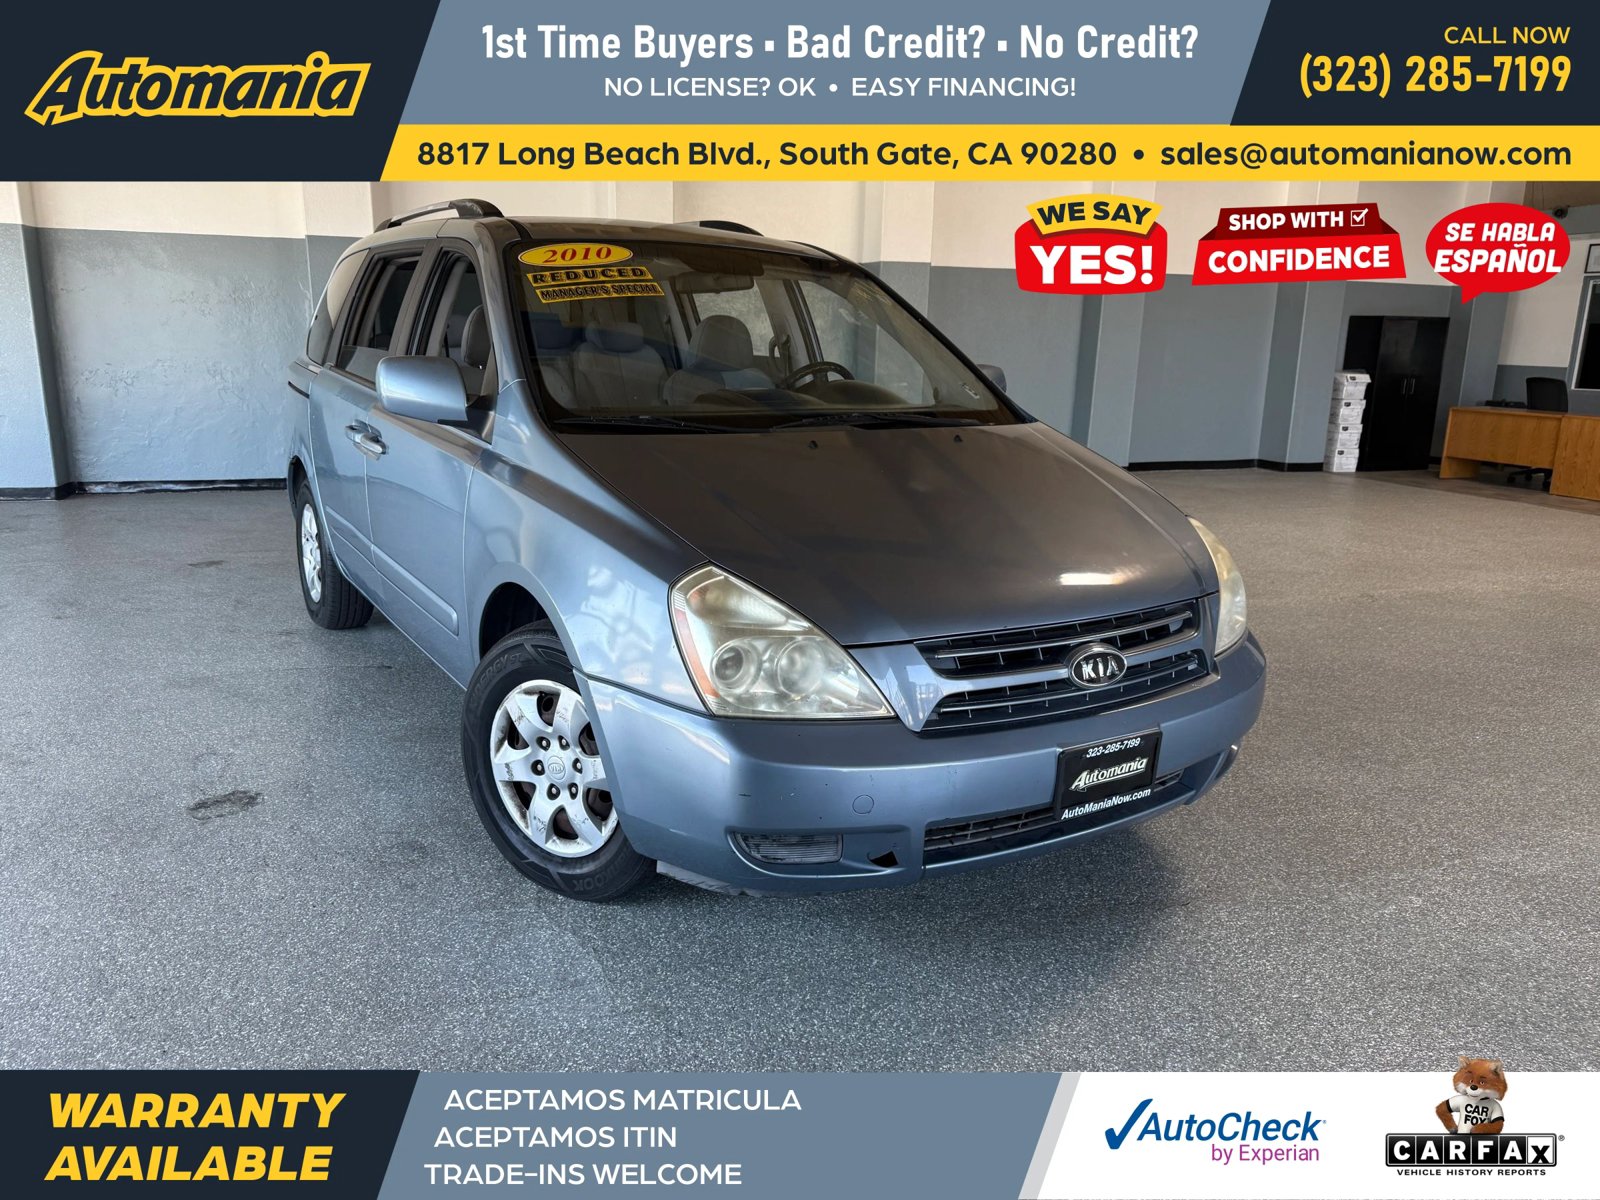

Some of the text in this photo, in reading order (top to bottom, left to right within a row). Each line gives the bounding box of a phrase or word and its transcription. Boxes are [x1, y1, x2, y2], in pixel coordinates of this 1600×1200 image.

[542, 246, 612, 264] 2010
[532, 267, 645, 284] REDUCED
[611, 283, 662, 296] SPECIAL
[1080, 655, 1120, 680] KIA
[1086, 738, 1141, 758] 323-285-7199
[1069, 757, 1149, 792] Automania
[1061, 788, 1152, 820] AutoManiaNow.com
